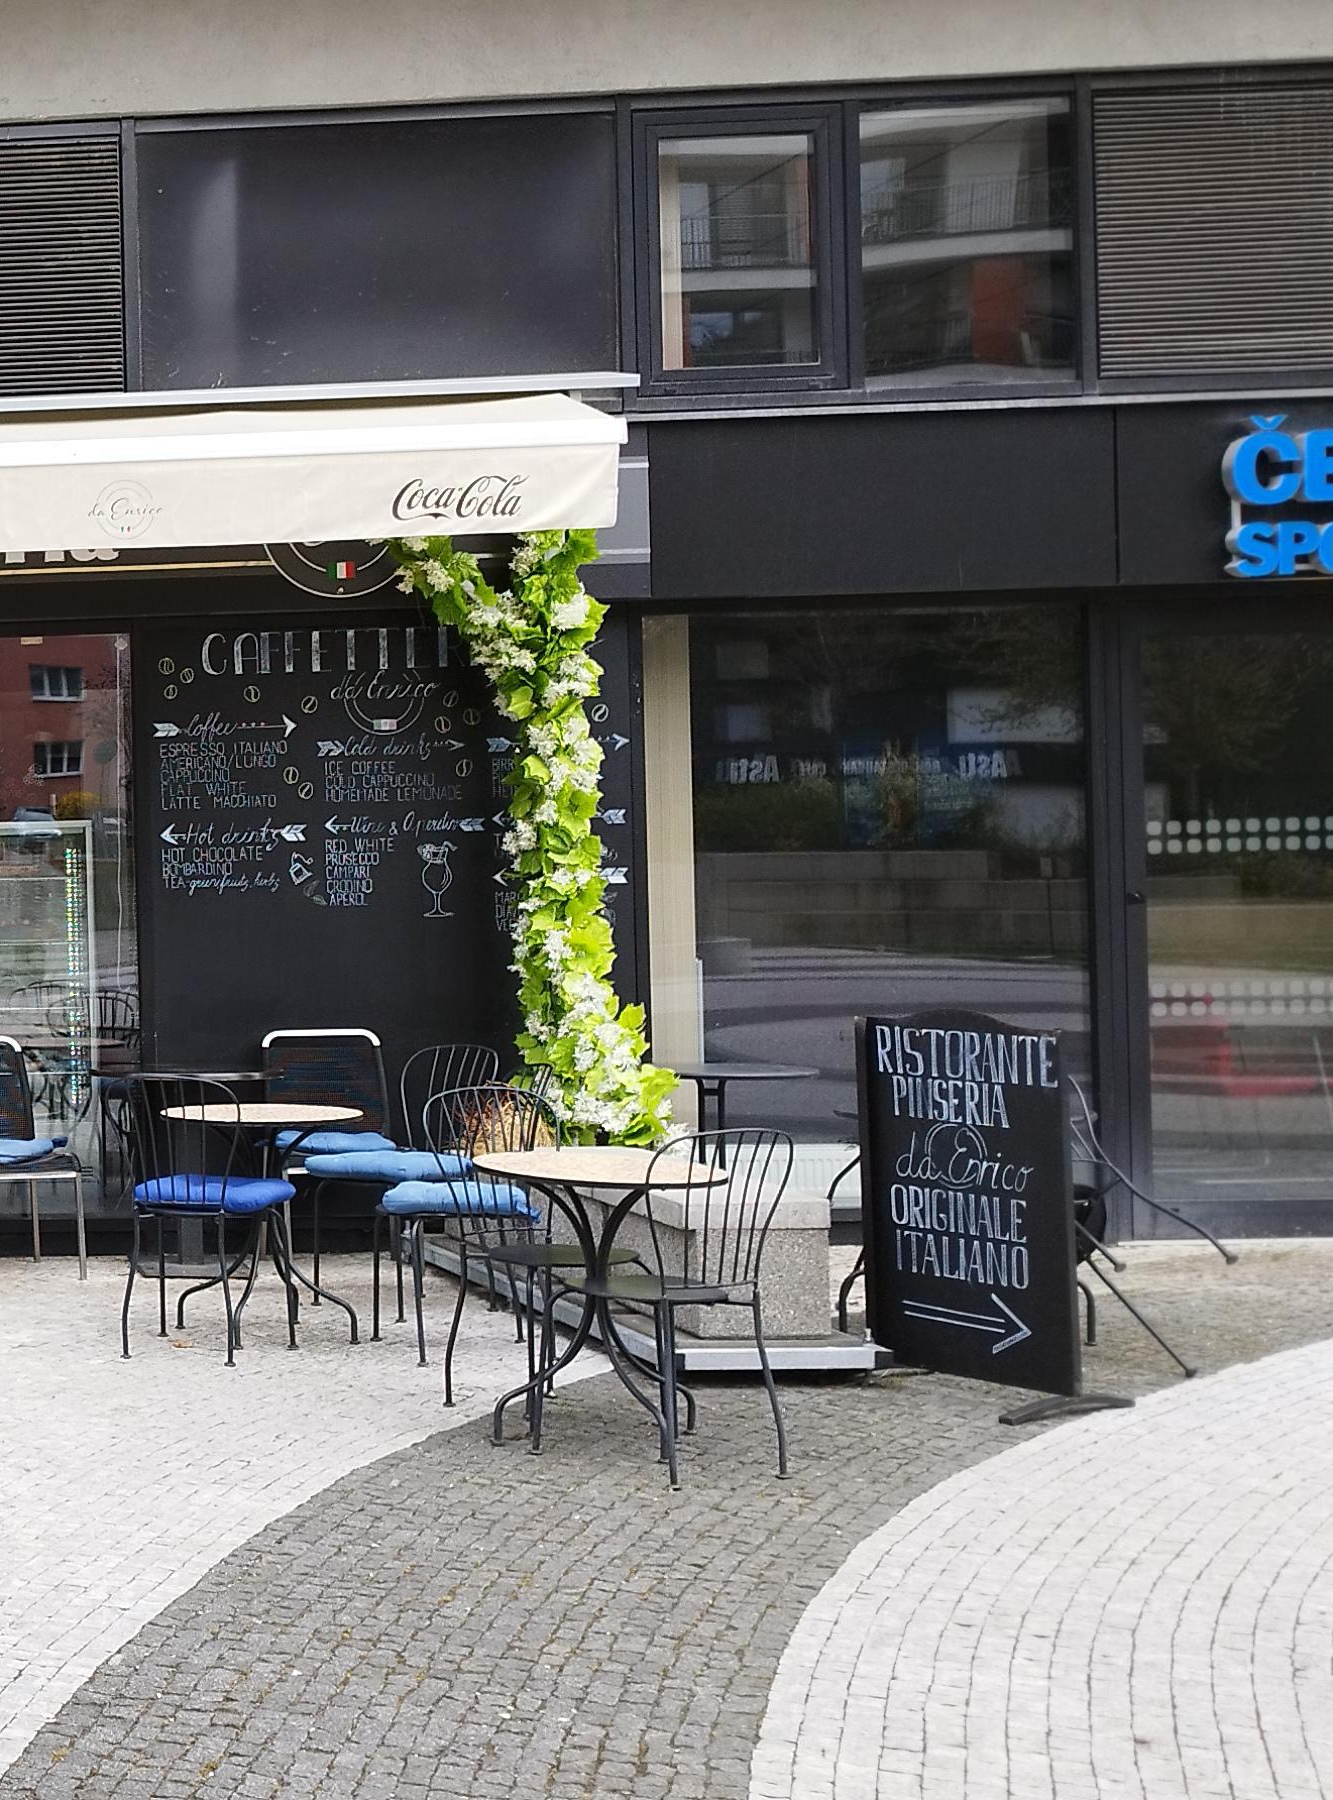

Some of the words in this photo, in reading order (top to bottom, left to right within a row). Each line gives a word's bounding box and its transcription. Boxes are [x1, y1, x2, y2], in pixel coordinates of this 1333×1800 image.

[392, 475, 530, 521] Coca-Cola
[201, 626, 469, 675] CAFFETTER
[187, 712, 237, 741] Coffee
[160, 742, 225, 758] ESPRESSO
[233, 740, 288, 755] ITALIANO
[160, 768, 230, 785] CAPPUCCINO
[324, 761, 343, 776] ICE
[351, 761, 396, 775] COFFEE
[161, 783, 192, 797] FLAT
[205, 781, 247, 796] WHITE
[325, 775, 356, 789] COLD
[362, 772, 435, 788] CAPPUCCINO
[397, 784, 463, 802] LEMONADE
[161, 795, 202, 811] LATTE
[186, 822, 214, 845] Hot
[389, 821, 398, 835] &
[355, 837, 395, 852] WHITE
[162, 847, 186, 863] HOT
[193, 845, 263, 862] CHOCOLATE
[325, 851, 380, 866] PROSECCO
[162, 862, 233, 877] BOMBARDINO
[326, 864, 370, 879] CAMPARI
[327, 878, 373, 894] CRODINO
[330, 893, 368, 907] APEROL
[875, 1025, 1059, 1089] RISTORANTE
[891, 1074, 1011, 1129] PINSERIA
[890, 1184, 1027, 1244] ORIGINALE
[896, 1229, 1029, 1290] ITALIANO
